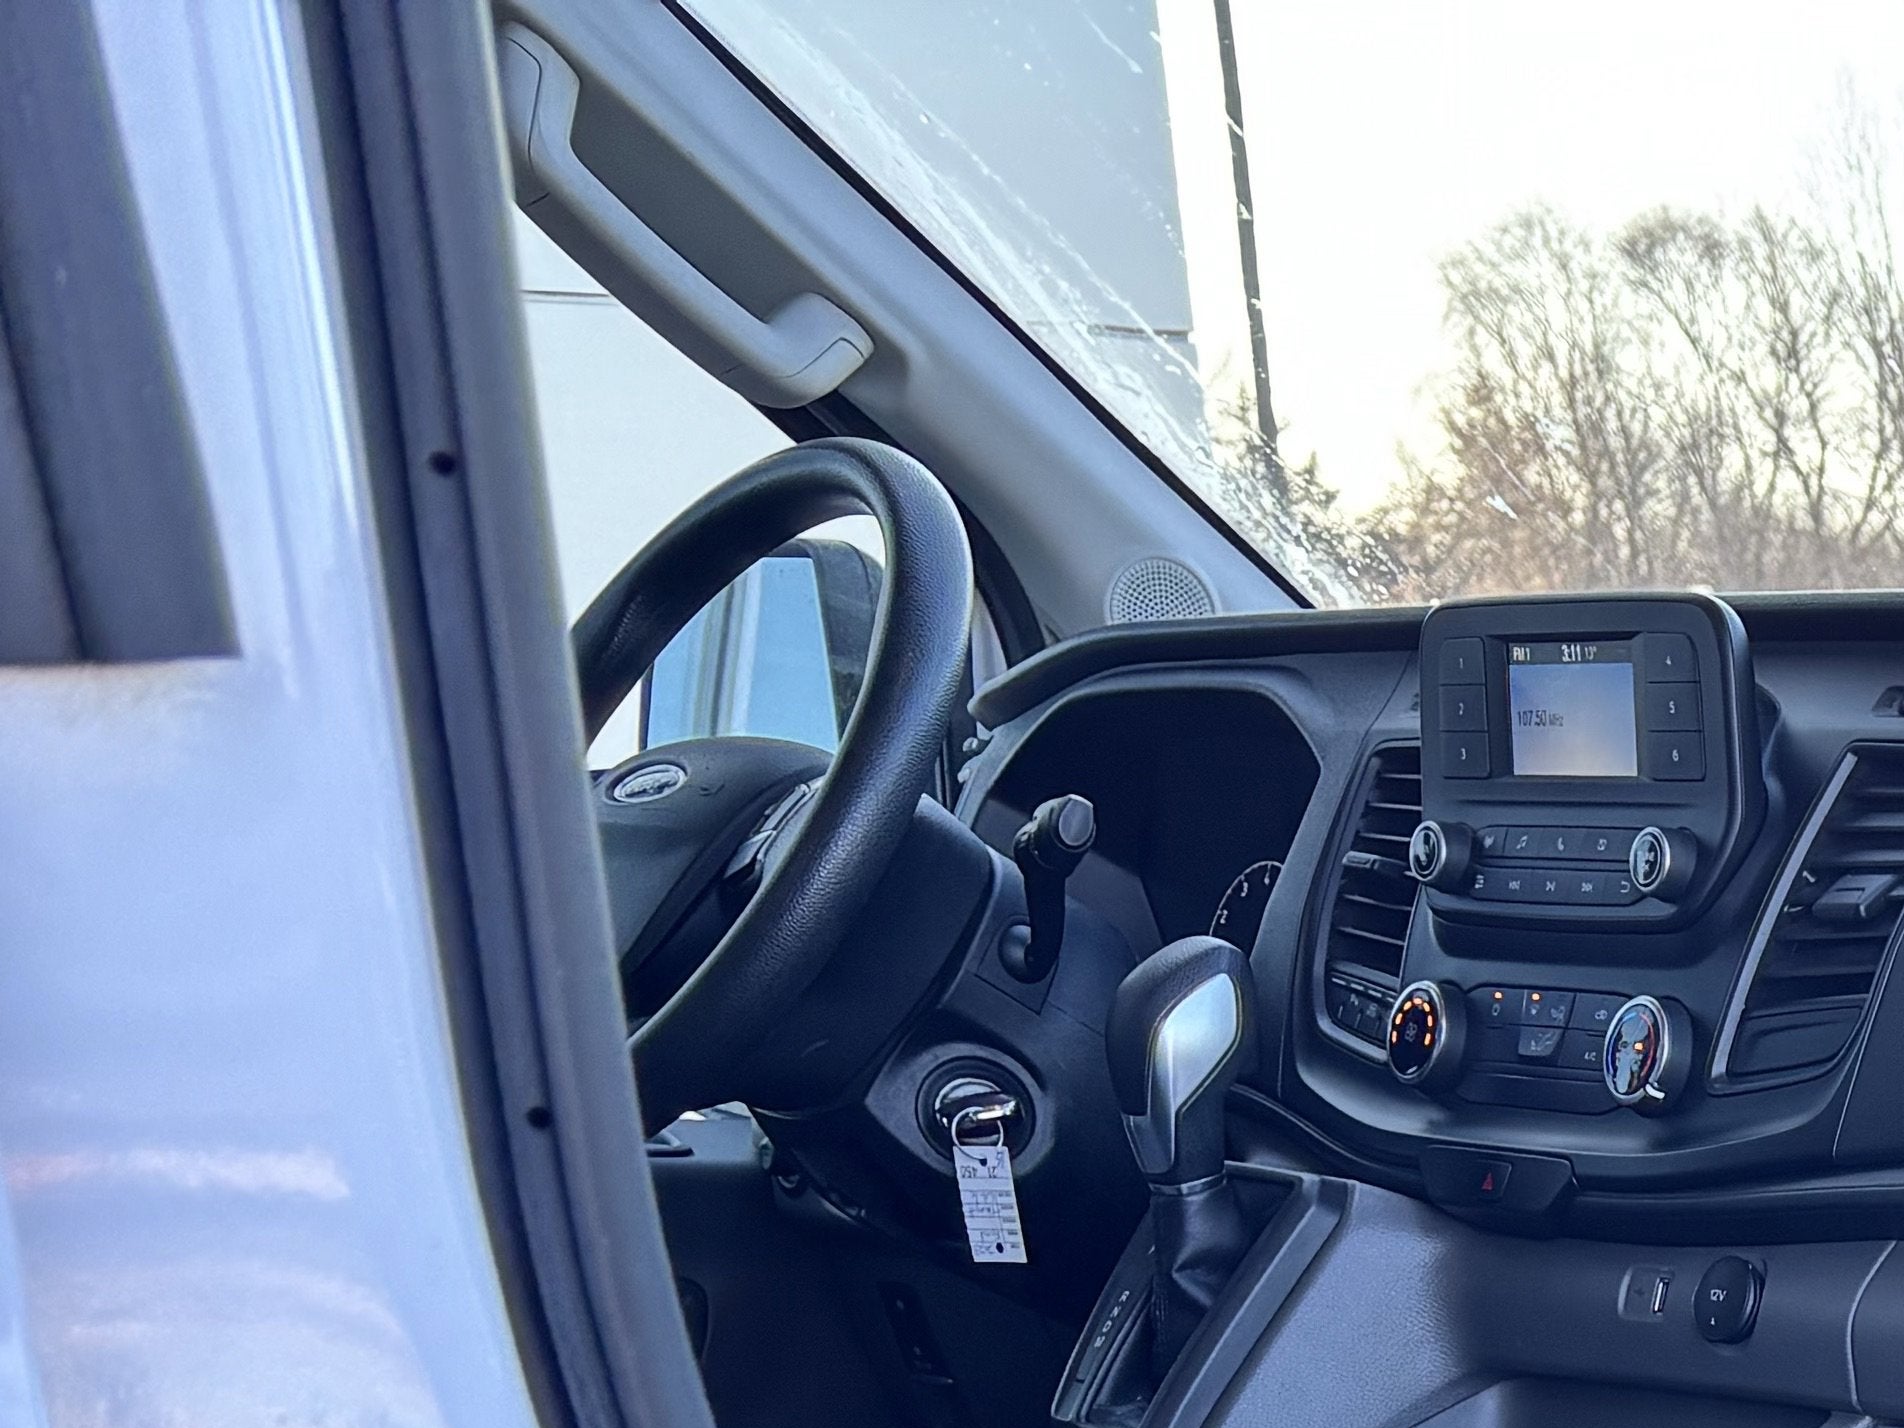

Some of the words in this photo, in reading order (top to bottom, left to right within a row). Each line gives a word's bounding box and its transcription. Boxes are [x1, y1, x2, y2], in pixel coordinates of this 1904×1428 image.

[1459, 703, 1464, 715] 2
[1669, 701, 1676, 714] 5
[1460, 748, 1467, 760] 3
[1672, 749, 1679, 762] 6
